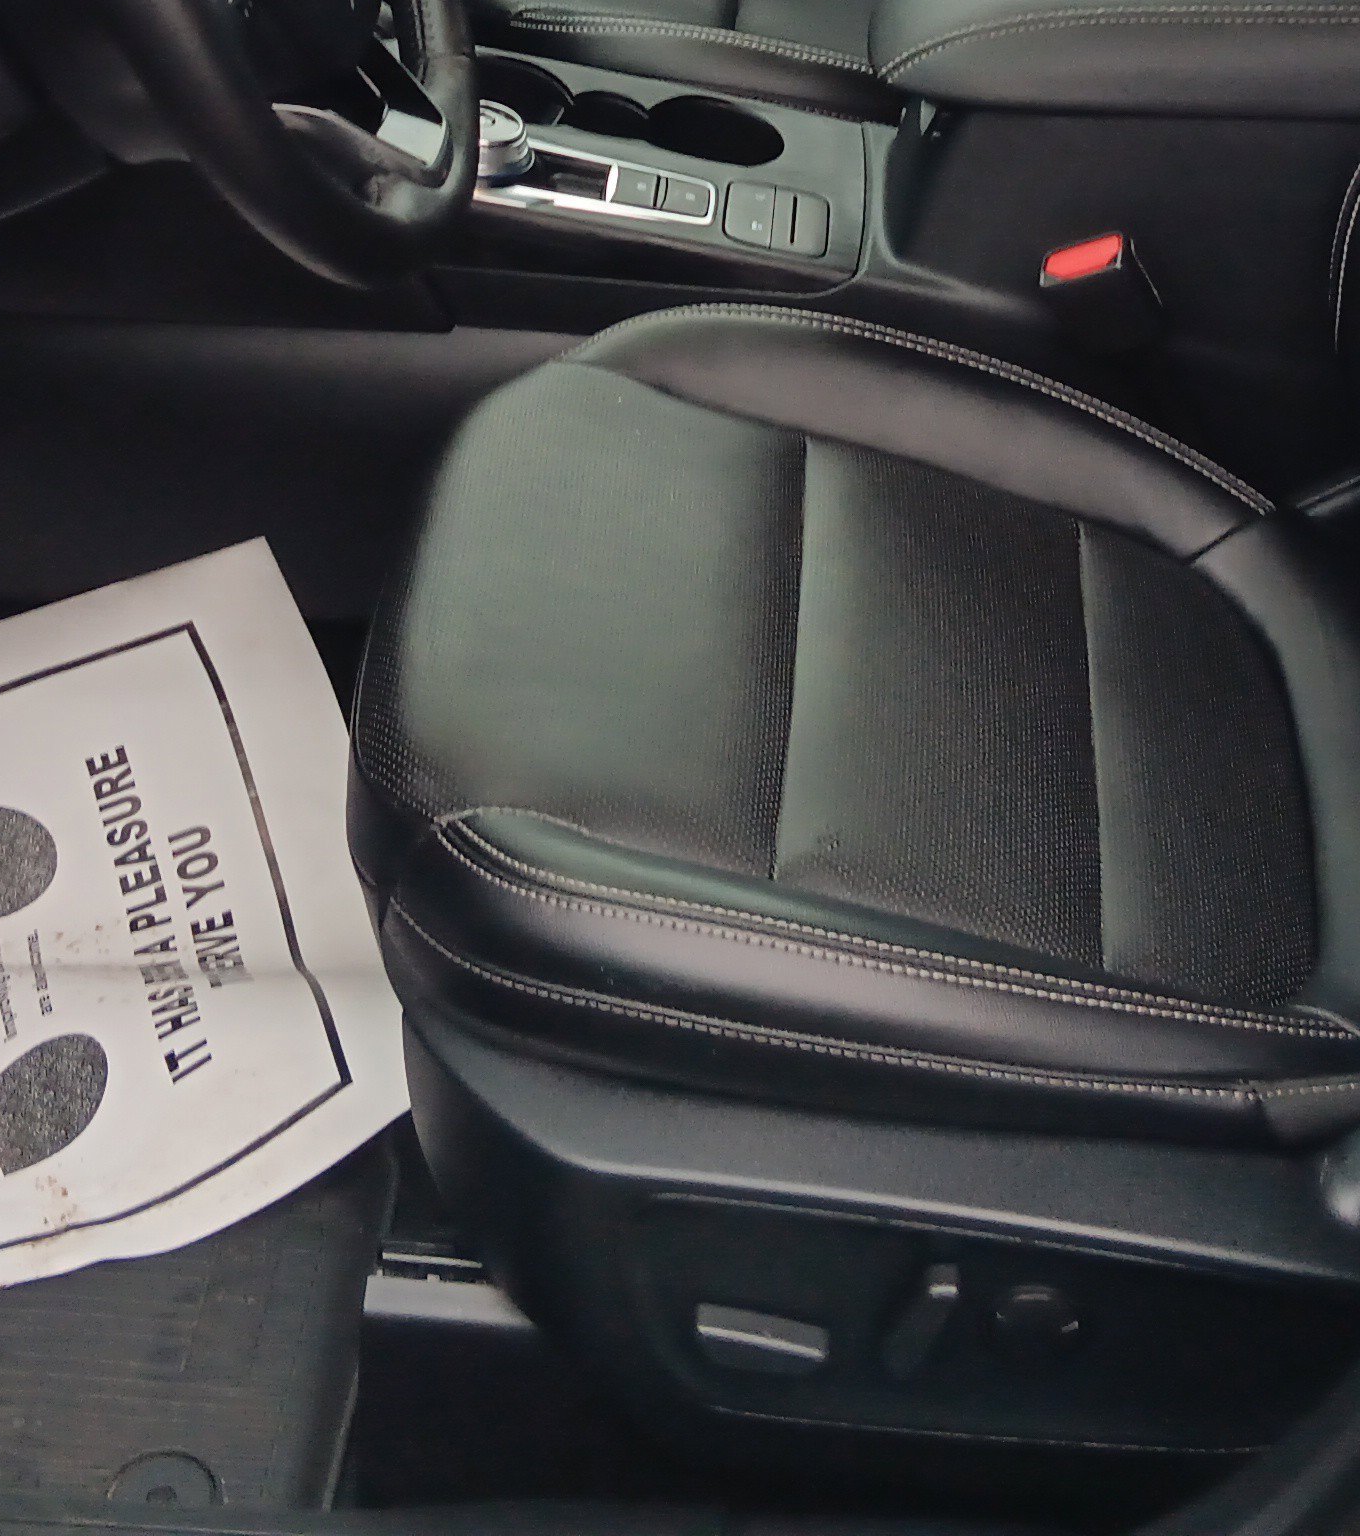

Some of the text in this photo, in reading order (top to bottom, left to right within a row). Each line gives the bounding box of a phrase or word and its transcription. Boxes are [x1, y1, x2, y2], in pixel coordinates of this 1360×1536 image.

[85, 745, 172, 933] PLEASURE
[167, 825, 225, 908] YOU
[133, 935, 178, 956] A
[147, 987, 201, 1041] HAS
[164, 1039, 212, 1084] IT
